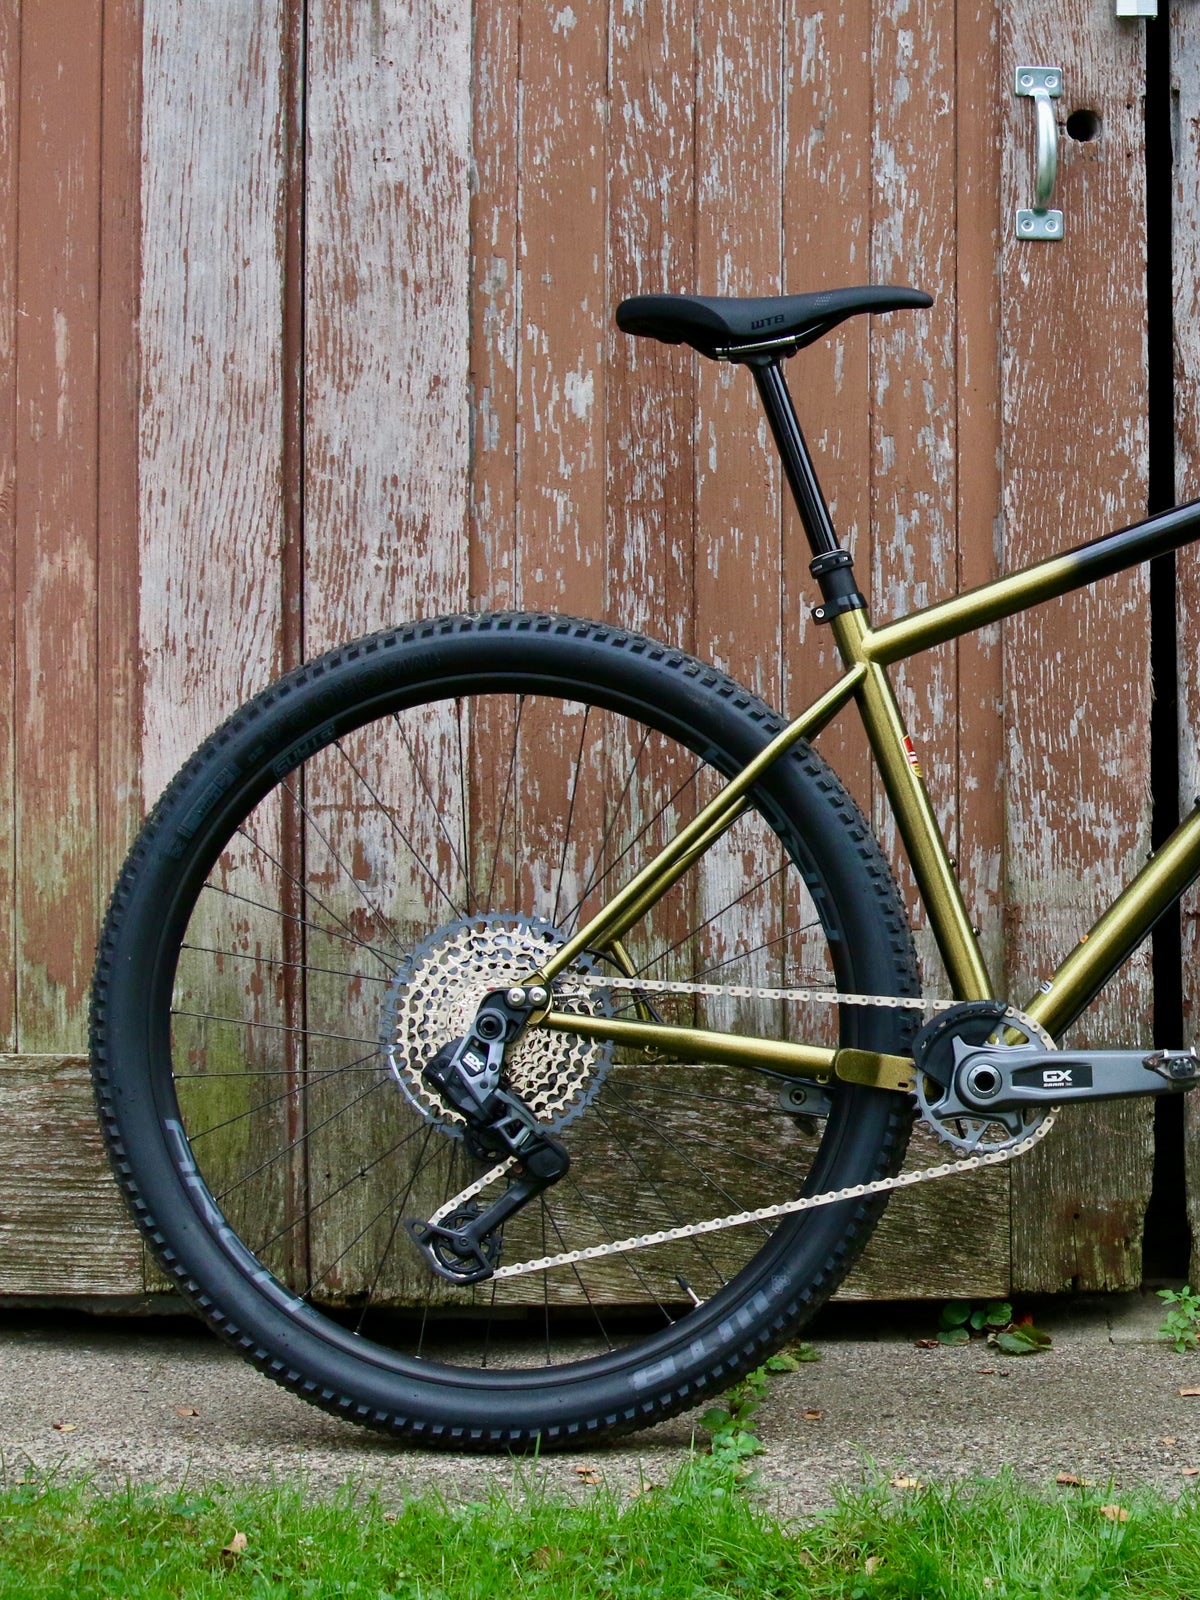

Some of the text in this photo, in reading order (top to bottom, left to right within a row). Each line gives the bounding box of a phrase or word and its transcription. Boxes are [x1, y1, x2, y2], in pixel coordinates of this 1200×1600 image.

[751, 315, 785, 331] WTB
[464, 1051, 485, 1070] GX
[1042, 1069, 1072, 1082] GX
